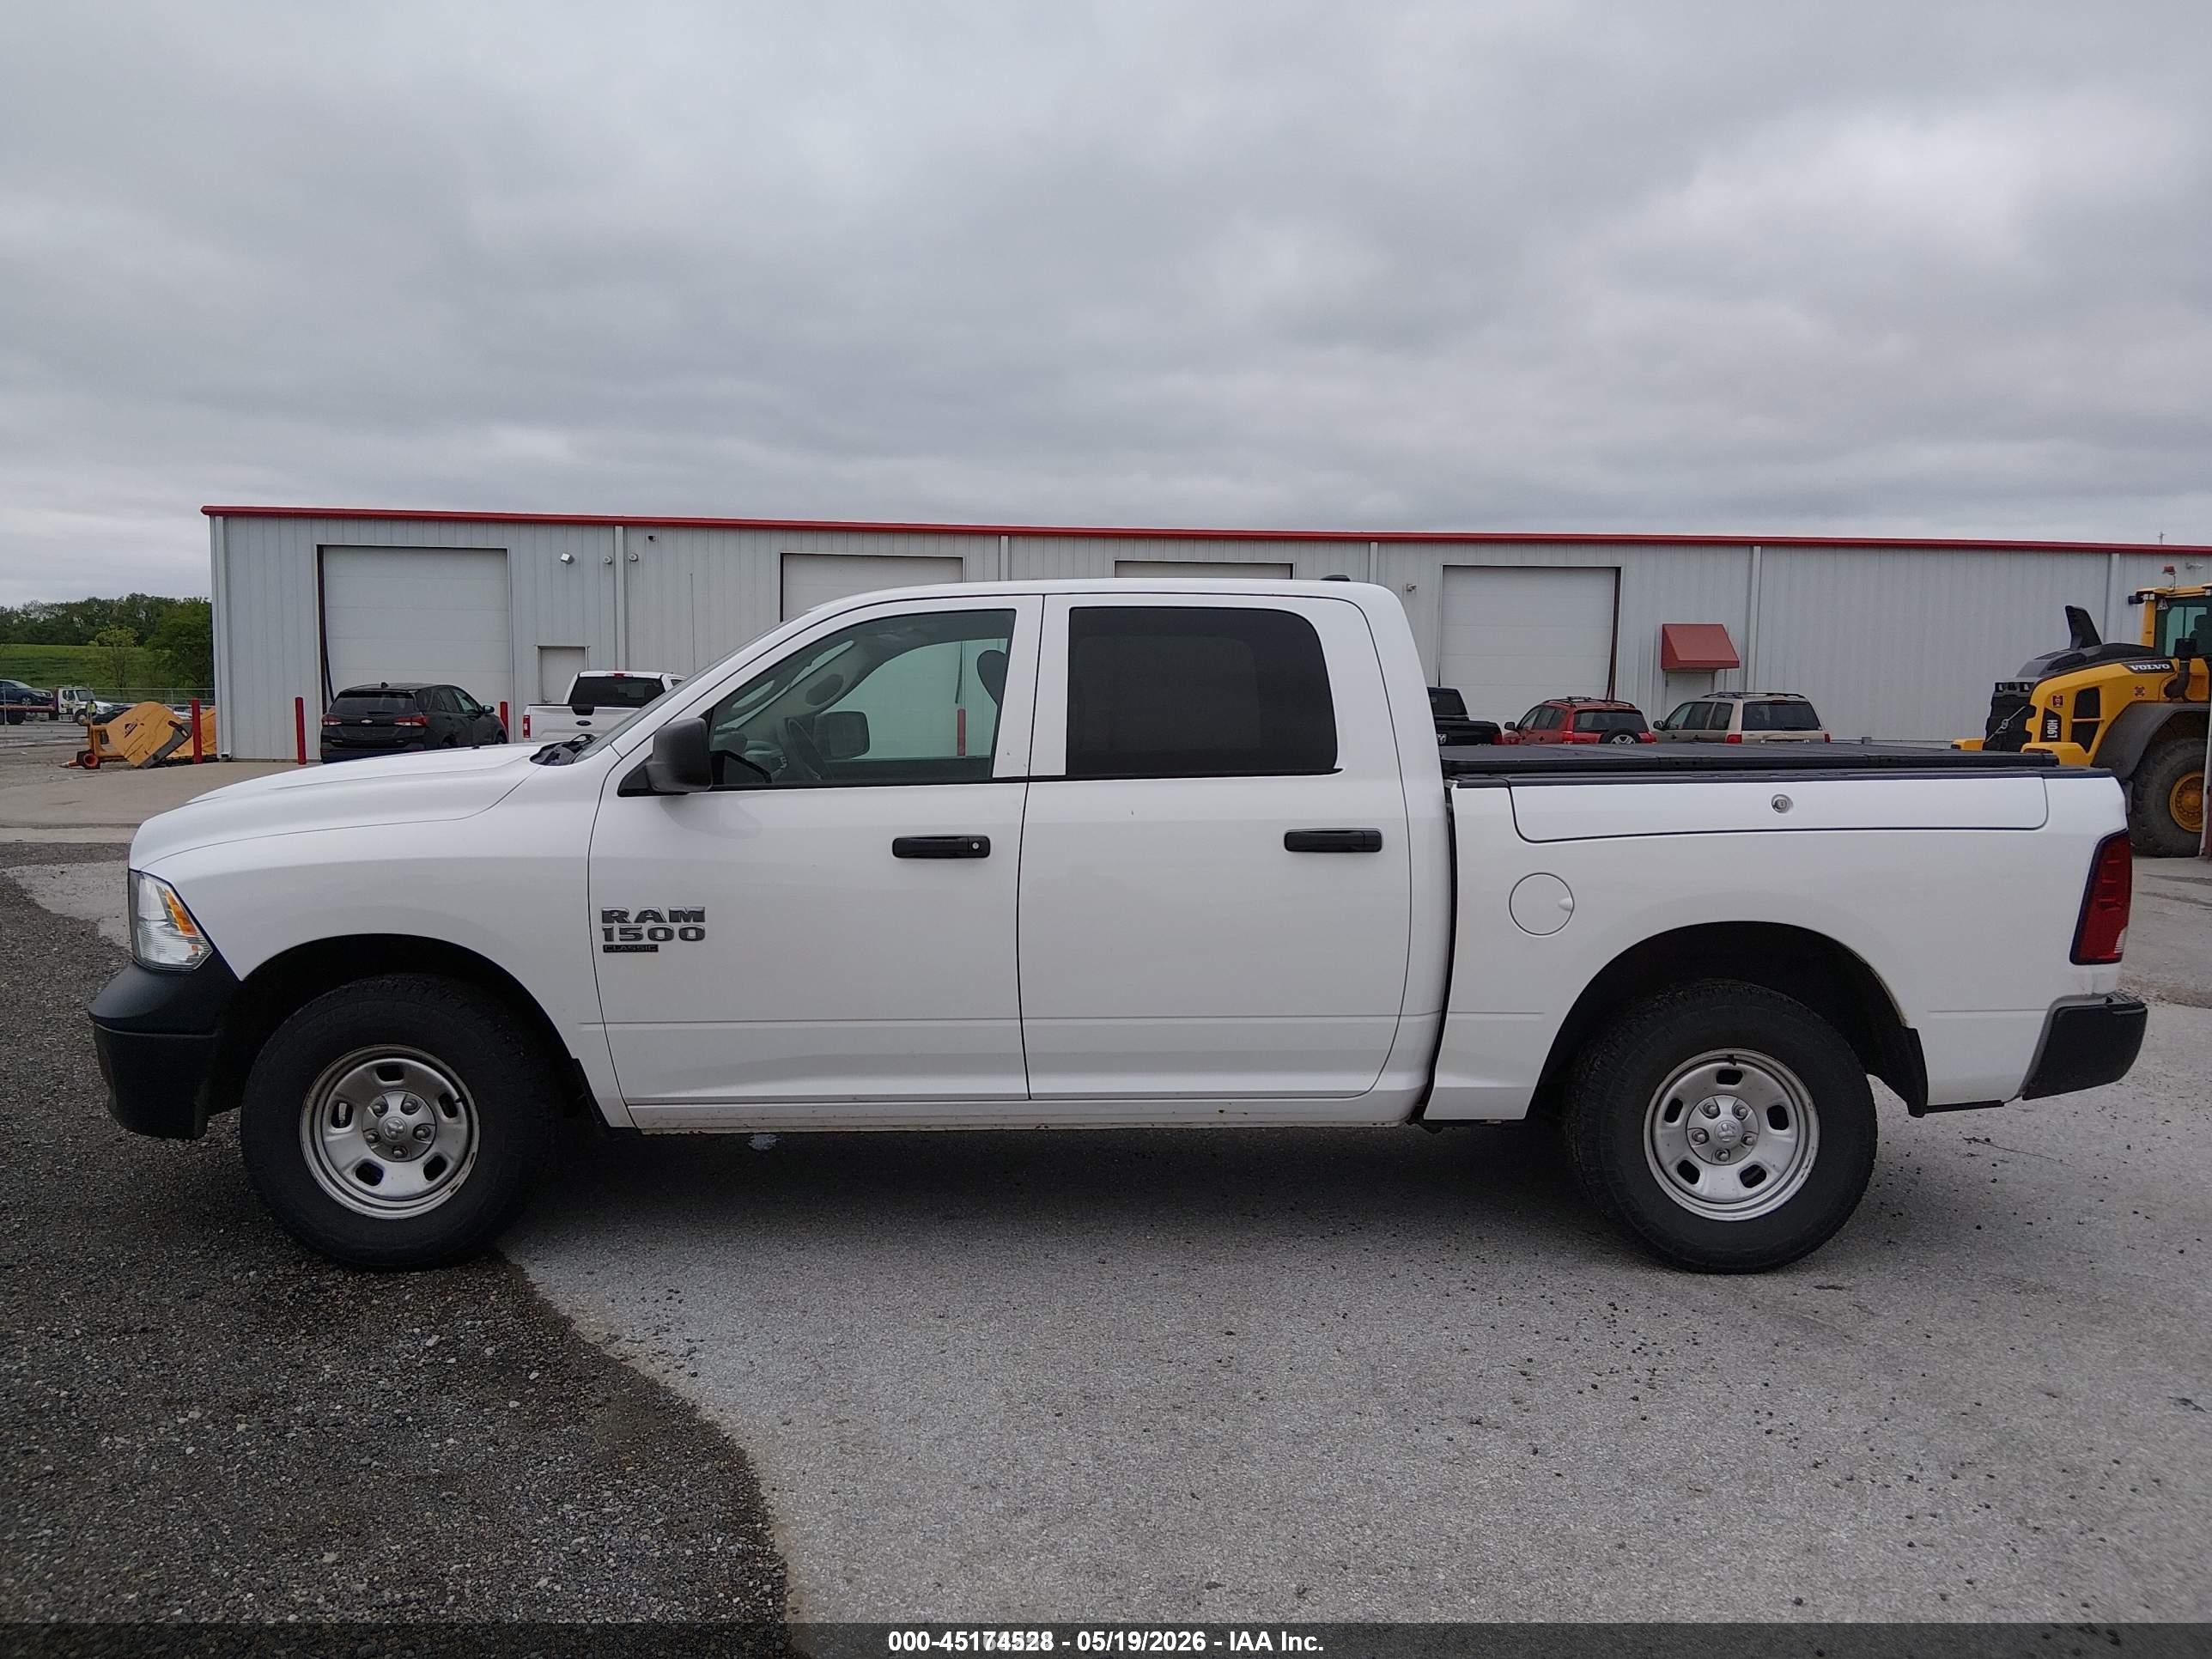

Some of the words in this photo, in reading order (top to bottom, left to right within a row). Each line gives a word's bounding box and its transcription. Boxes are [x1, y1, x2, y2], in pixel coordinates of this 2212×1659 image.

[2046, 719, 2058, 738] L90H
[601, 907, 705, 923] RAM
[602, 925, 705, 942] 1500
